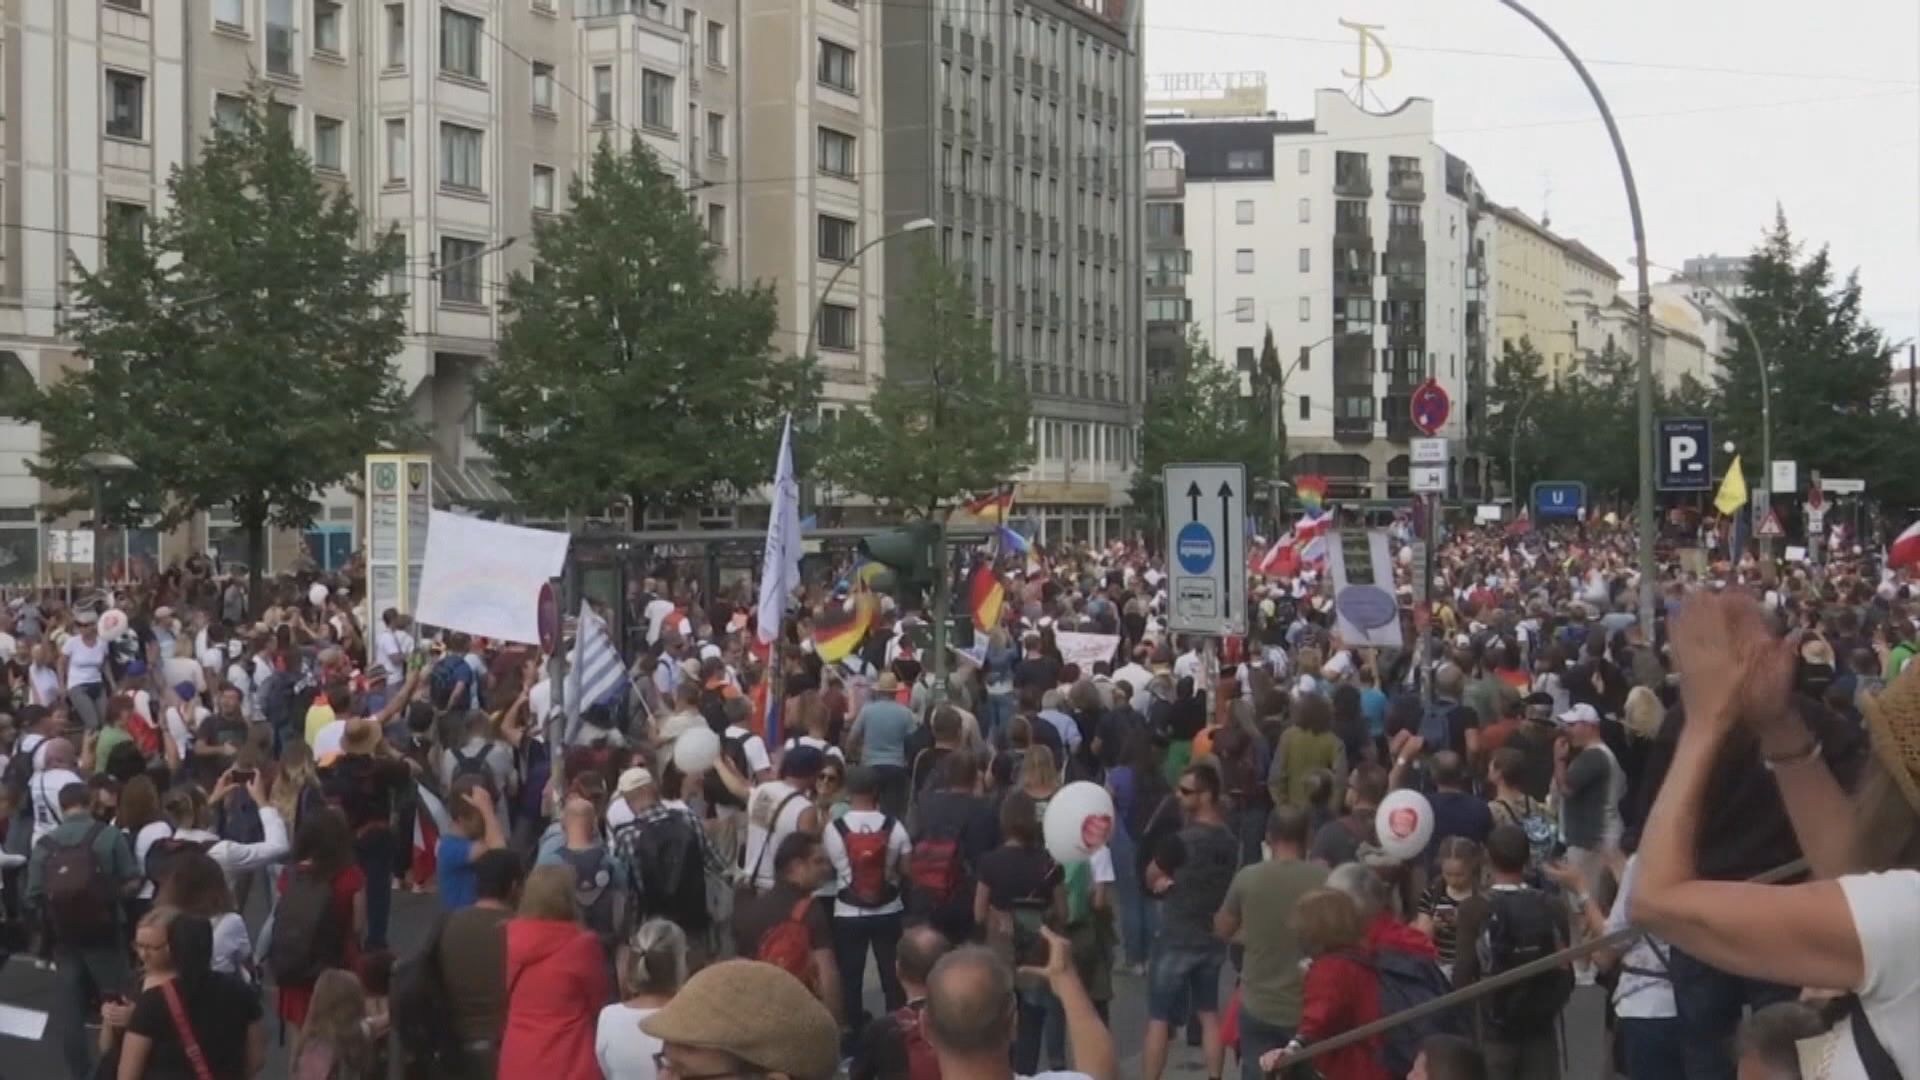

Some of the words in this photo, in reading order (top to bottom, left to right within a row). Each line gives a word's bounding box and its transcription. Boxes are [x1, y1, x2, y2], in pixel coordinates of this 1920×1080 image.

[1160, 71, 1266, 90] THEATER
[1670, 436, 1698, 473] P
[1552, 490, 1564, 505] U
